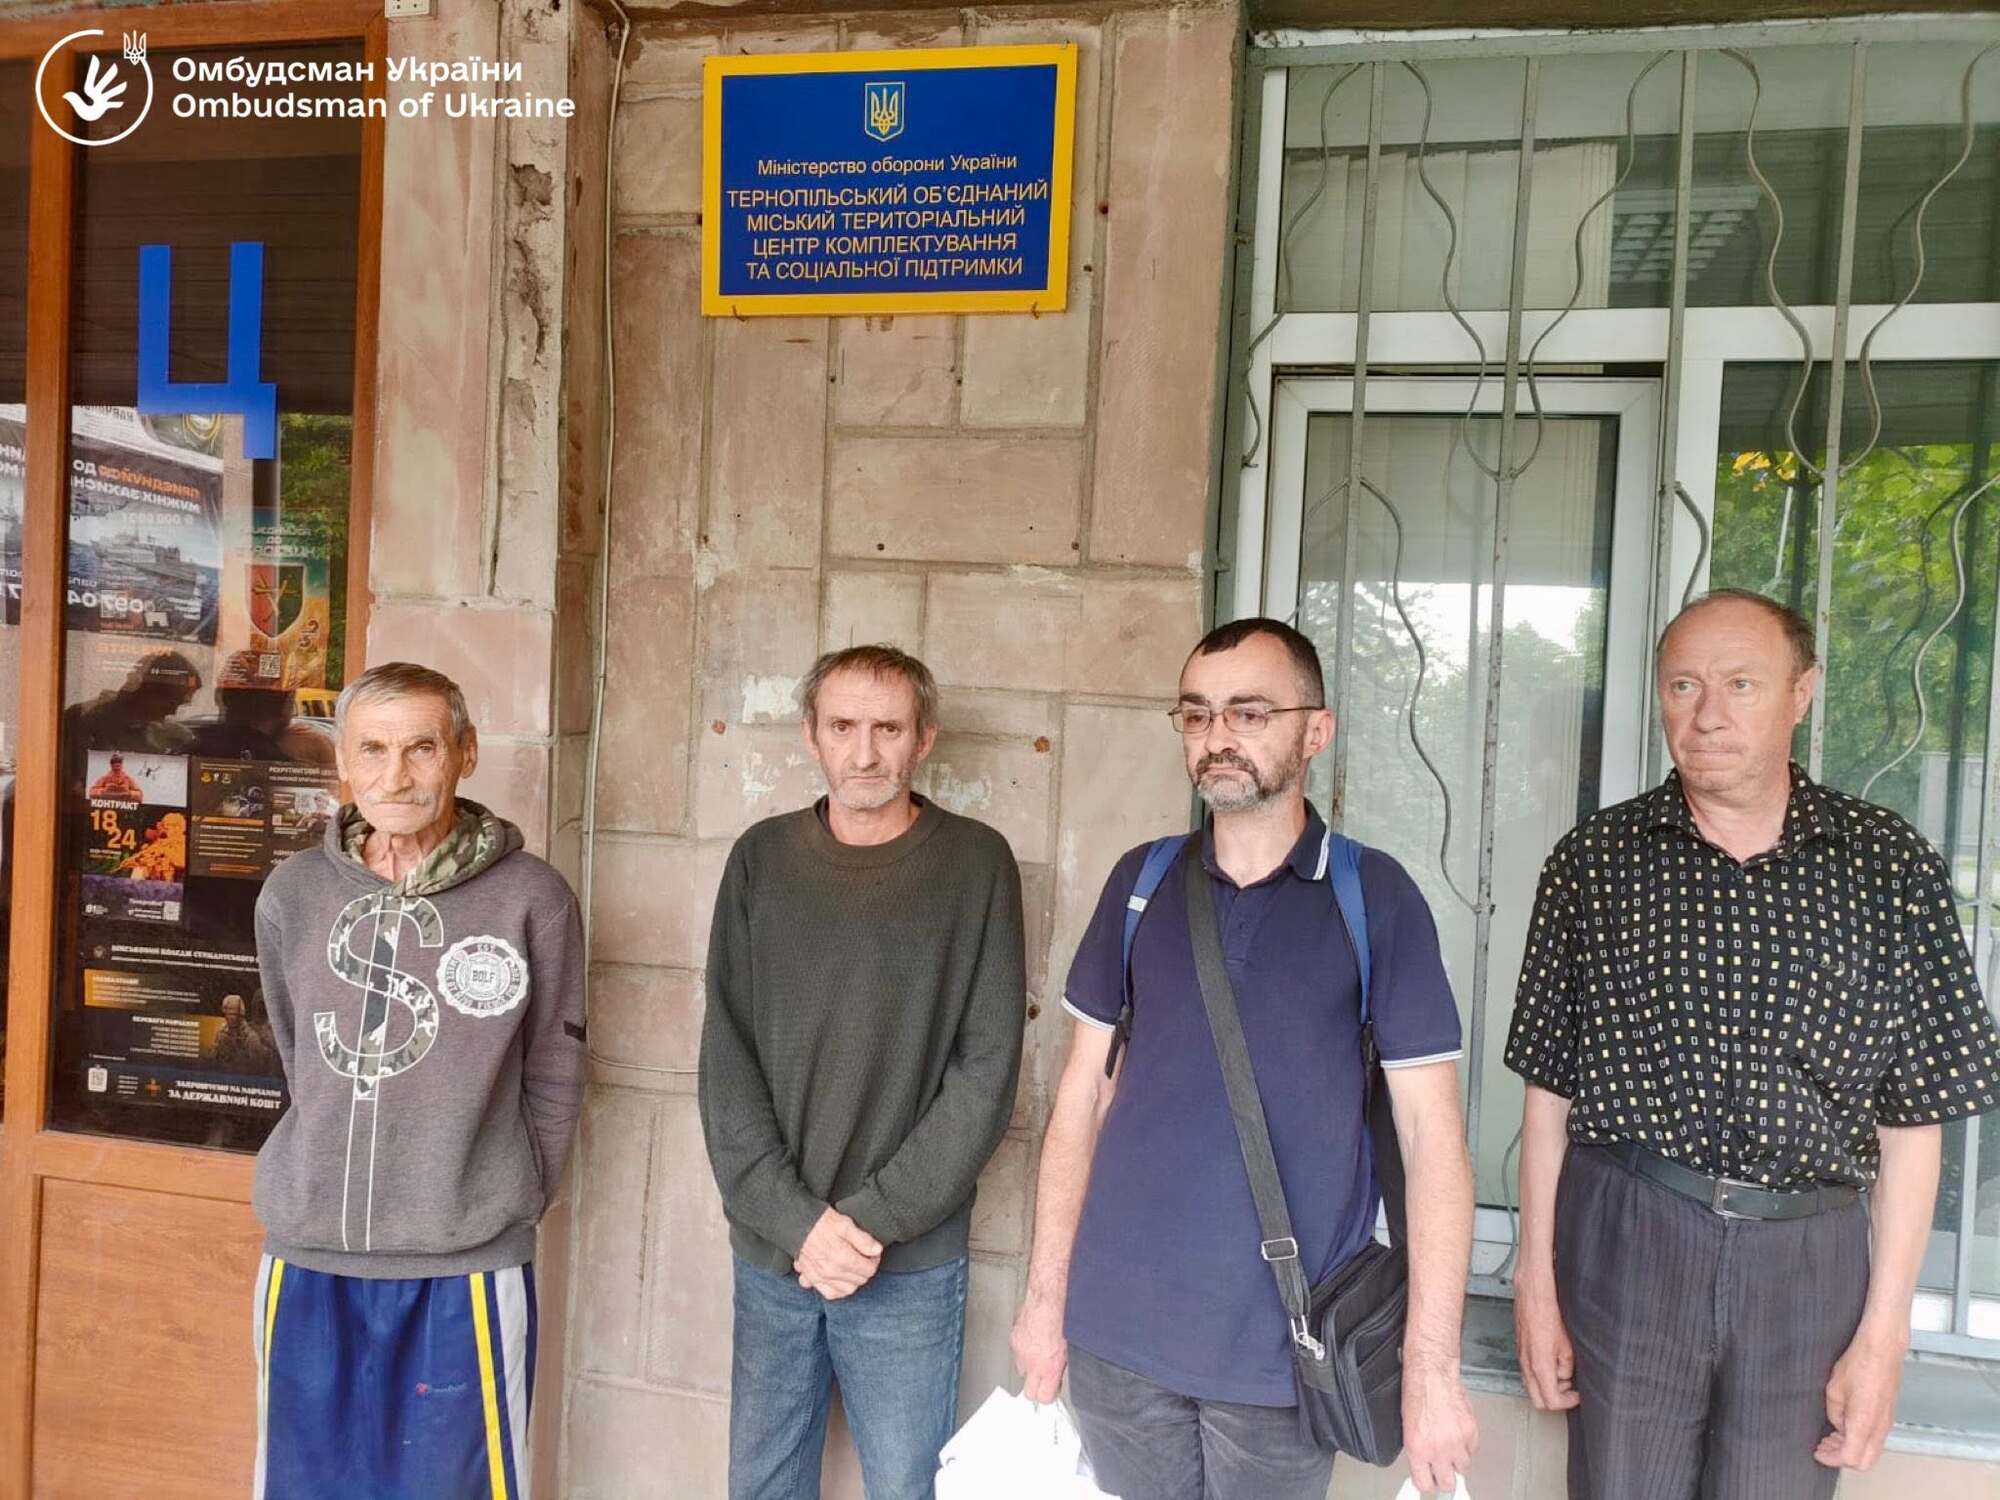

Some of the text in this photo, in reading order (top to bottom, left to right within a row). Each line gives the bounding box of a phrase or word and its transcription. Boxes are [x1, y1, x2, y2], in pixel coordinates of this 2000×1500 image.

[757, 153, 1018, 177] Міністерство оборони України
[727, 178, 1048, 209] ТЕРНОПІЛЬСЬКИЙ ОБ'ЄДНАНИЙ
[747, 204, 1025, 232] МІСЬКИЙ ТЕРИТОРІАЛЬНИЙ
[753, 232, 1016, 259] ЦЕНТР КОМПЛЕКТУВАННЯ
[746, 255, 1023, 283] ТА СОЦІАЛЬНОЇ ПІДТРИМКИ
[90, 798, 139, 811] КОНТРАКТ
[90, 809, 118, 832] 18
[107, 829, 137, 850] 24
[182, 1090, 249, 1105] ДЕРЖАВНИЙ
